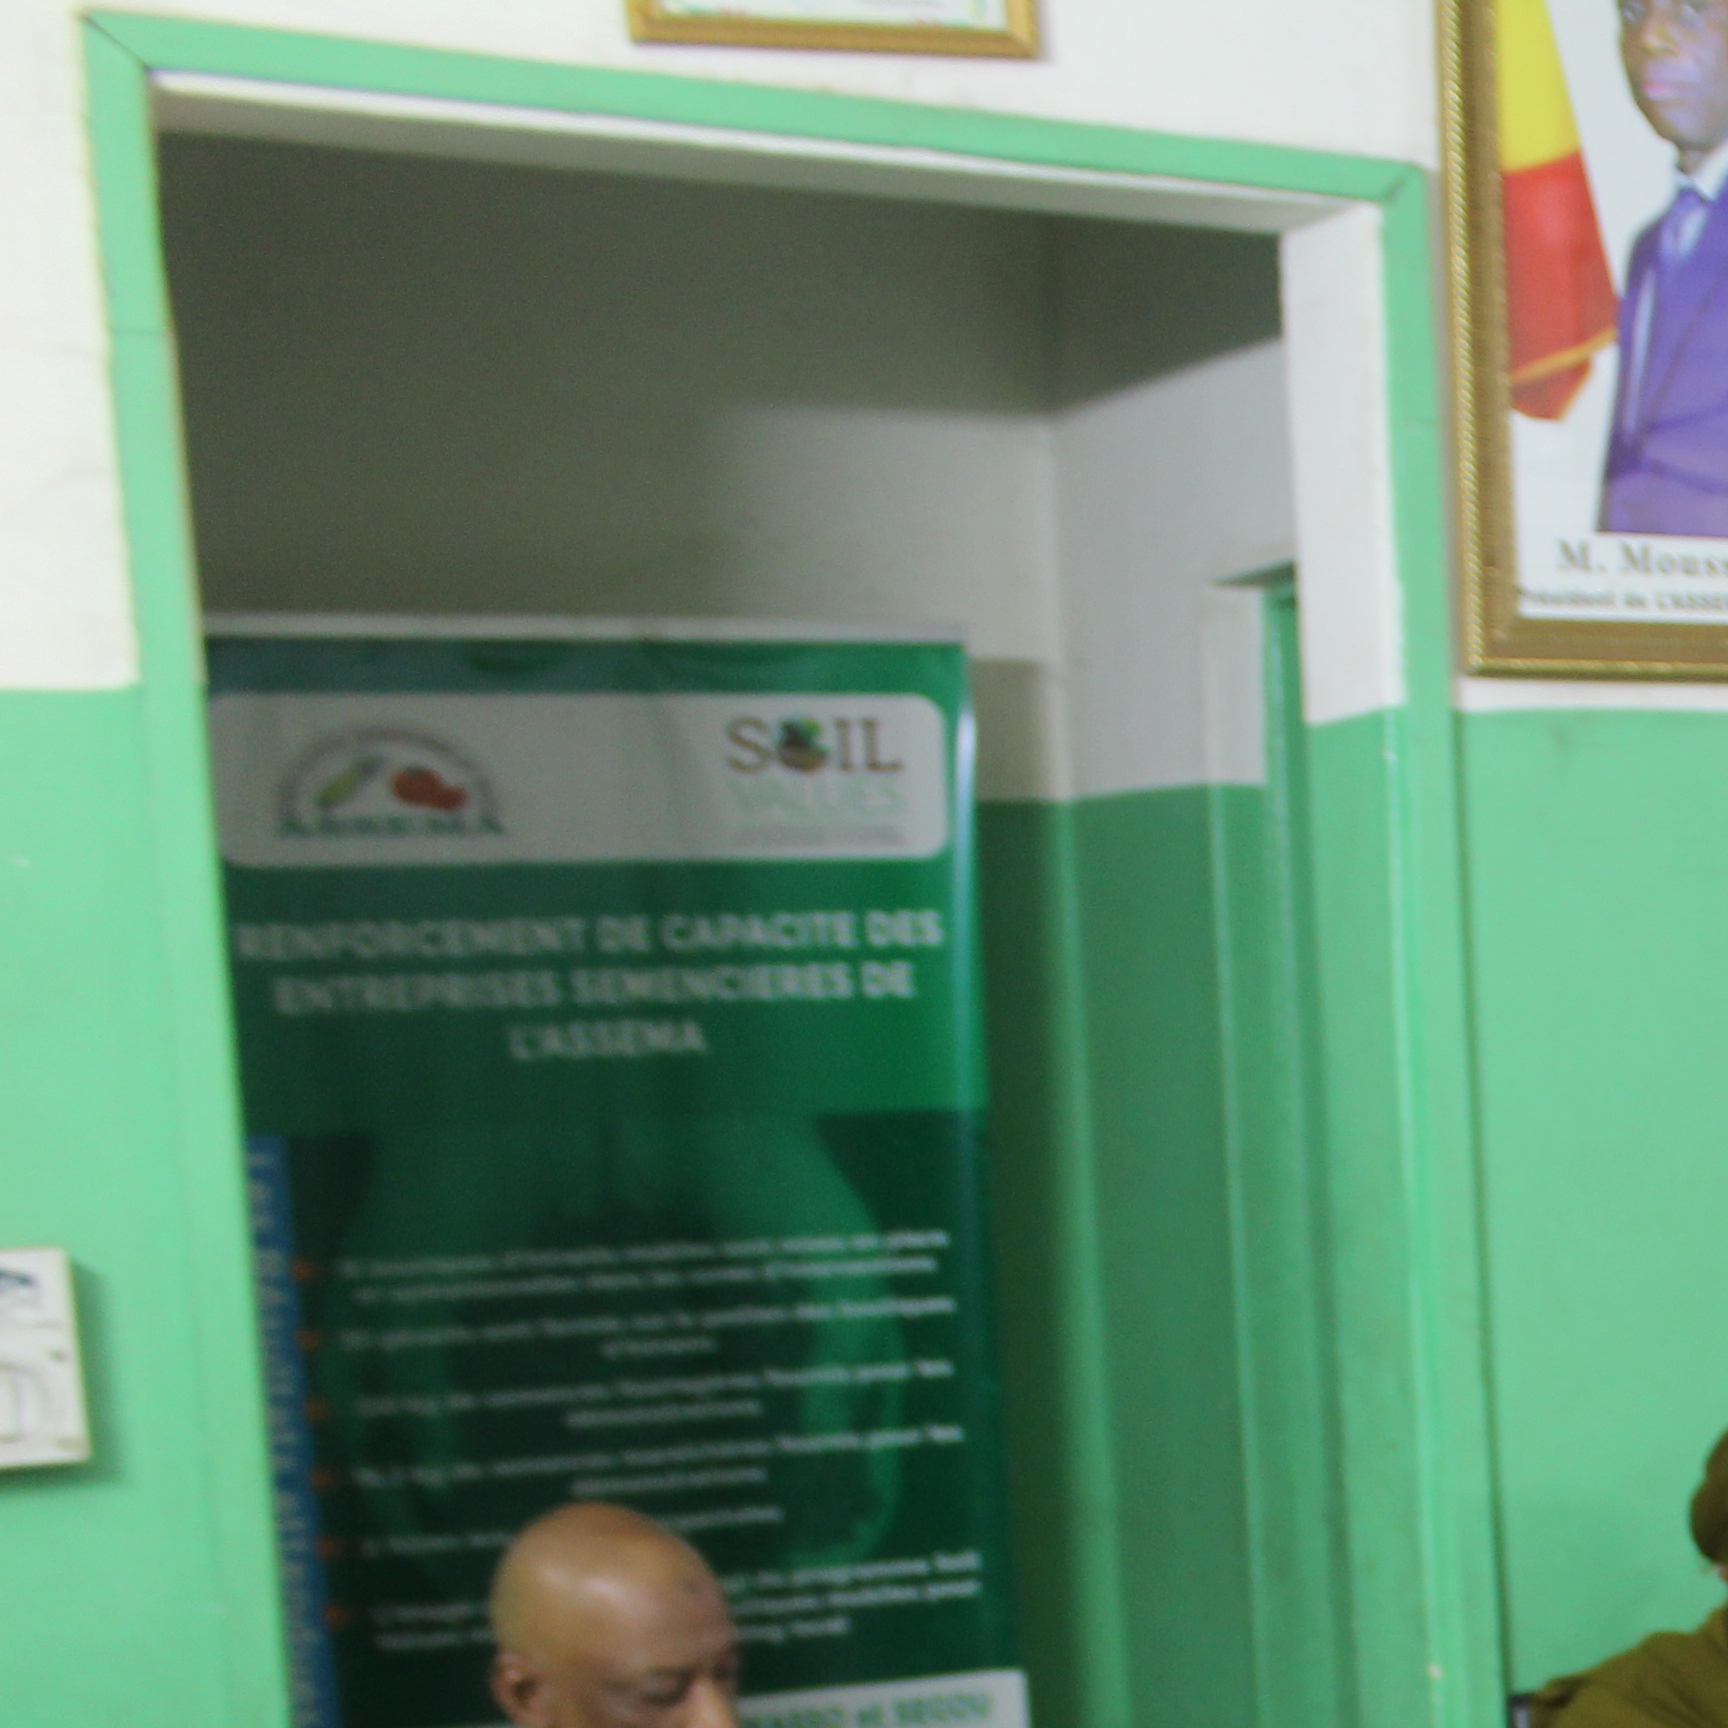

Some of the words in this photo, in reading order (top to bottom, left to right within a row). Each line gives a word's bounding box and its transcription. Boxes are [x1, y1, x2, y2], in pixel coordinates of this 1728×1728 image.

[1556, 538, 1607, 573] M.
[236, 918, 584, 961] RENFORCEMENT
[598, 913, 650, 952] DE
[661, 911, 857, 952] CAPACITE
[865, 908, 943, 948] DES
[275, 970, 558, 1015] ENTREPRISES
[571, 961, 853, 1004] SEMENCIERES
[861, 959, 914, 999] DE
[508, 1018, 709, 1061] L'ASSEMA
